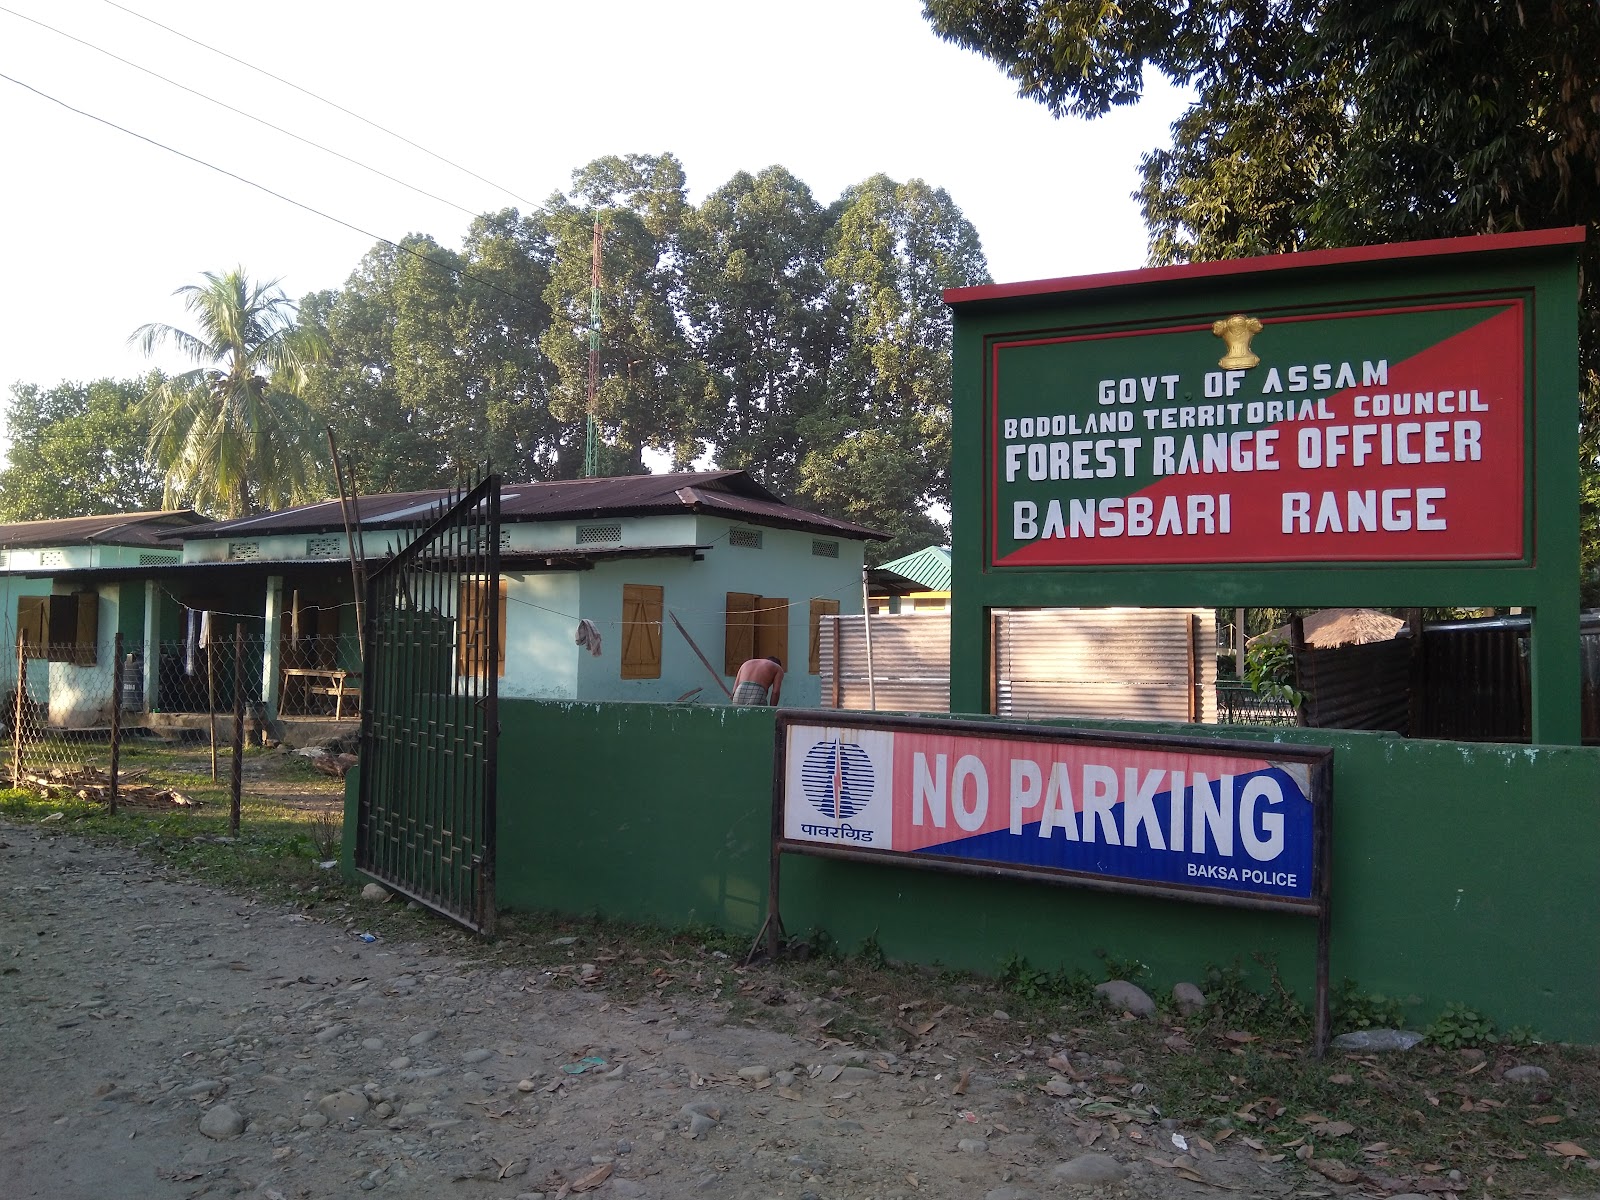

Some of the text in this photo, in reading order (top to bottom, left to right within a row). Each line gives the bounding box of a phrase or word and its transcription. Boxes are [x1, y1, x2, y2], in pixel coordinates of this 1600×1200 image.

[1204, 370, 1246, 398] OF
[1261, 360, 1389, 395] ASSAM
[1004, 389, 1489, 439] BODOLAND TERRITORIAL COUNCIL
[1005, 421, 1482, 482] FOREST RANGE OFFICER
[1013, 488, 1447, 540] BANSBARI RANGE
[912, 752, 1284, 862] NO PARKING
[801, 822, 873, 843] पावरग्रिड
[1187, 863, 1297, 888] BAKSA POLICE
